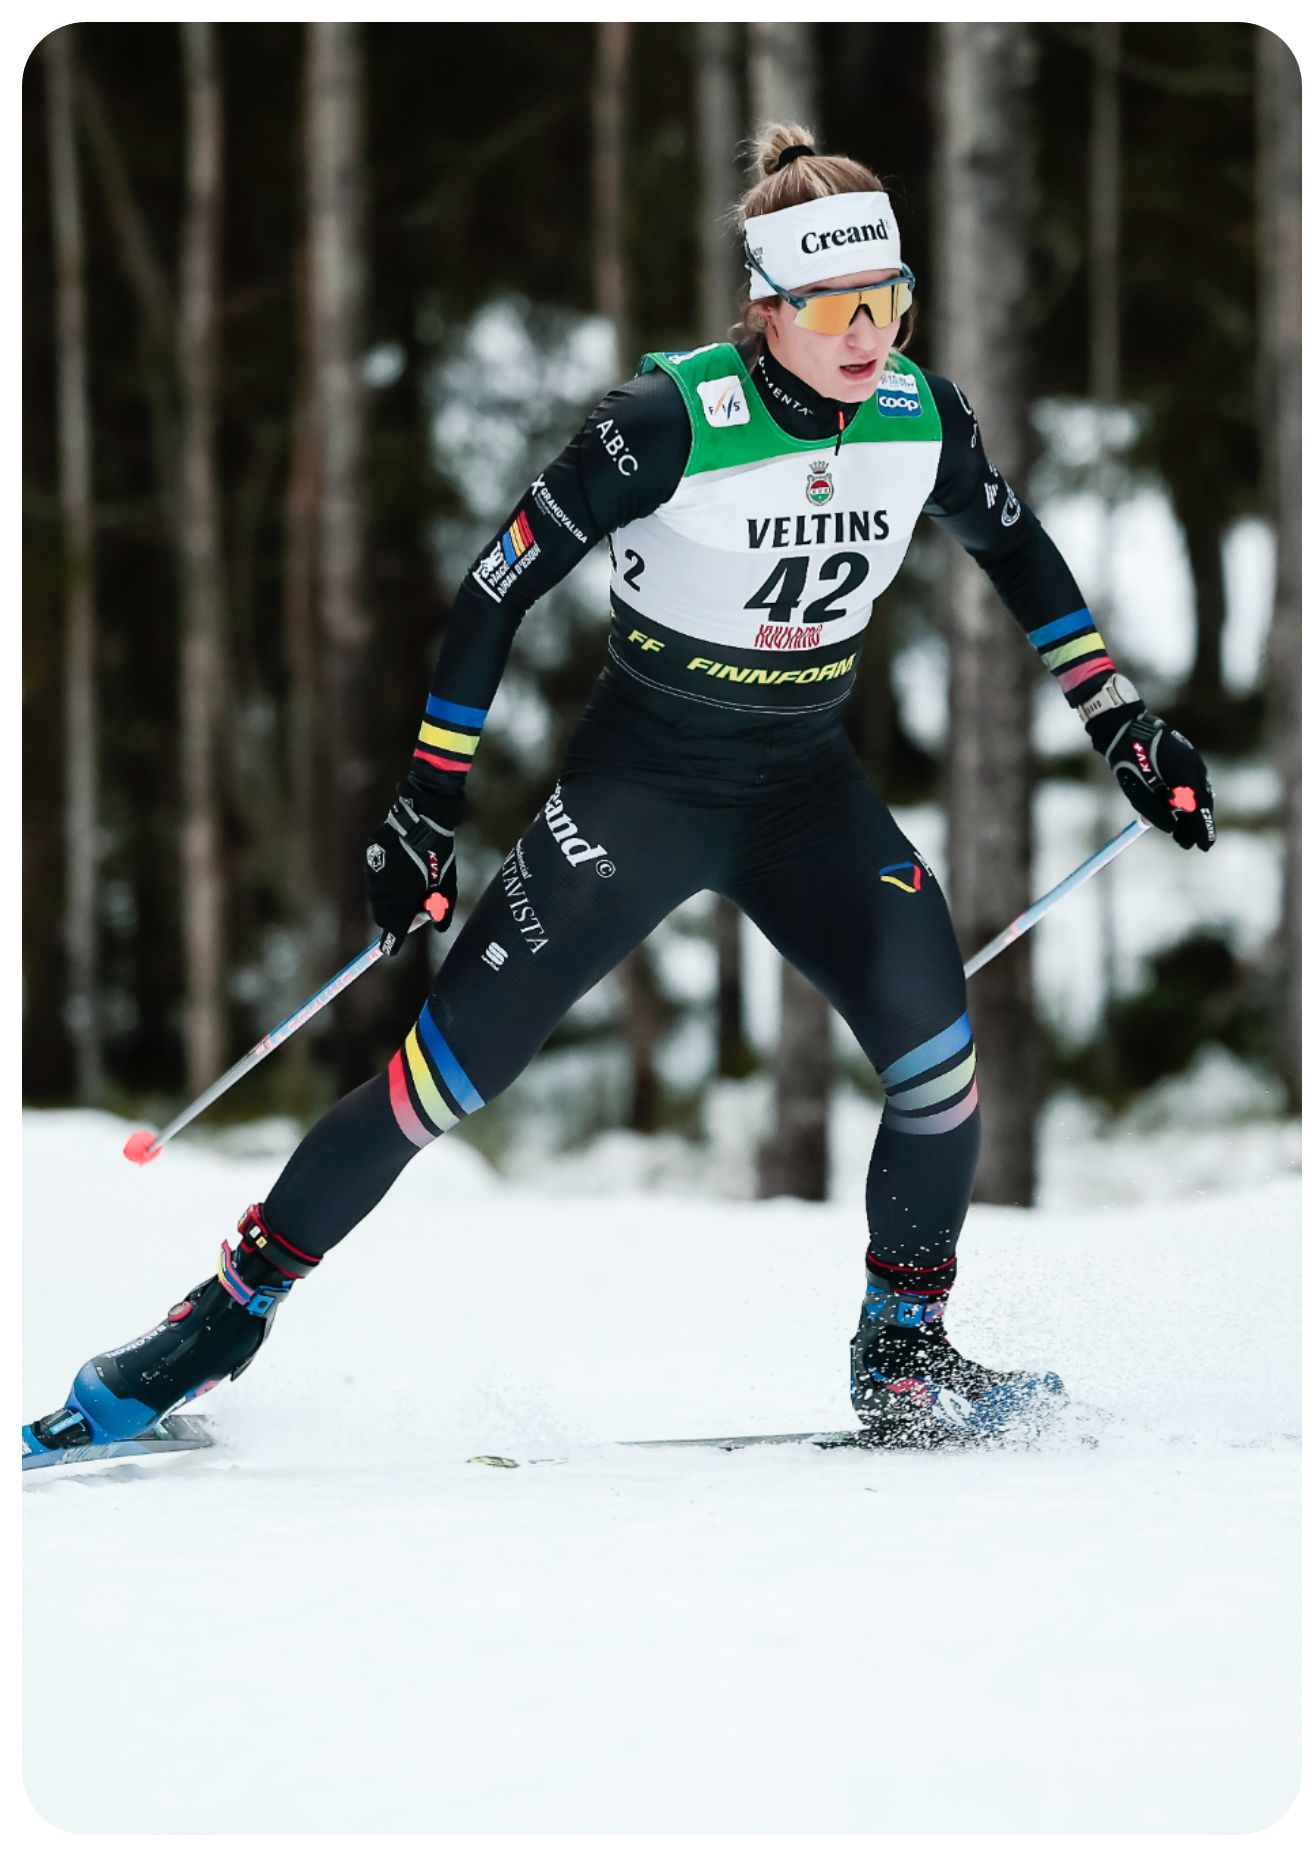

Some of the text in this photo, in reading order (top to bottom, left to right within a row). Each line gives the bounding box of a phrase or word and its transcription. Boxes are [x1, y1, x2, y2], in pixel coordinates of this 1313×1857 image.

[878, 396, 920, 412] coop
[746, 509, 890, 549] VELTINS
[743, 550, 870, 624] 42
[627, 629, 666, 652] FF
